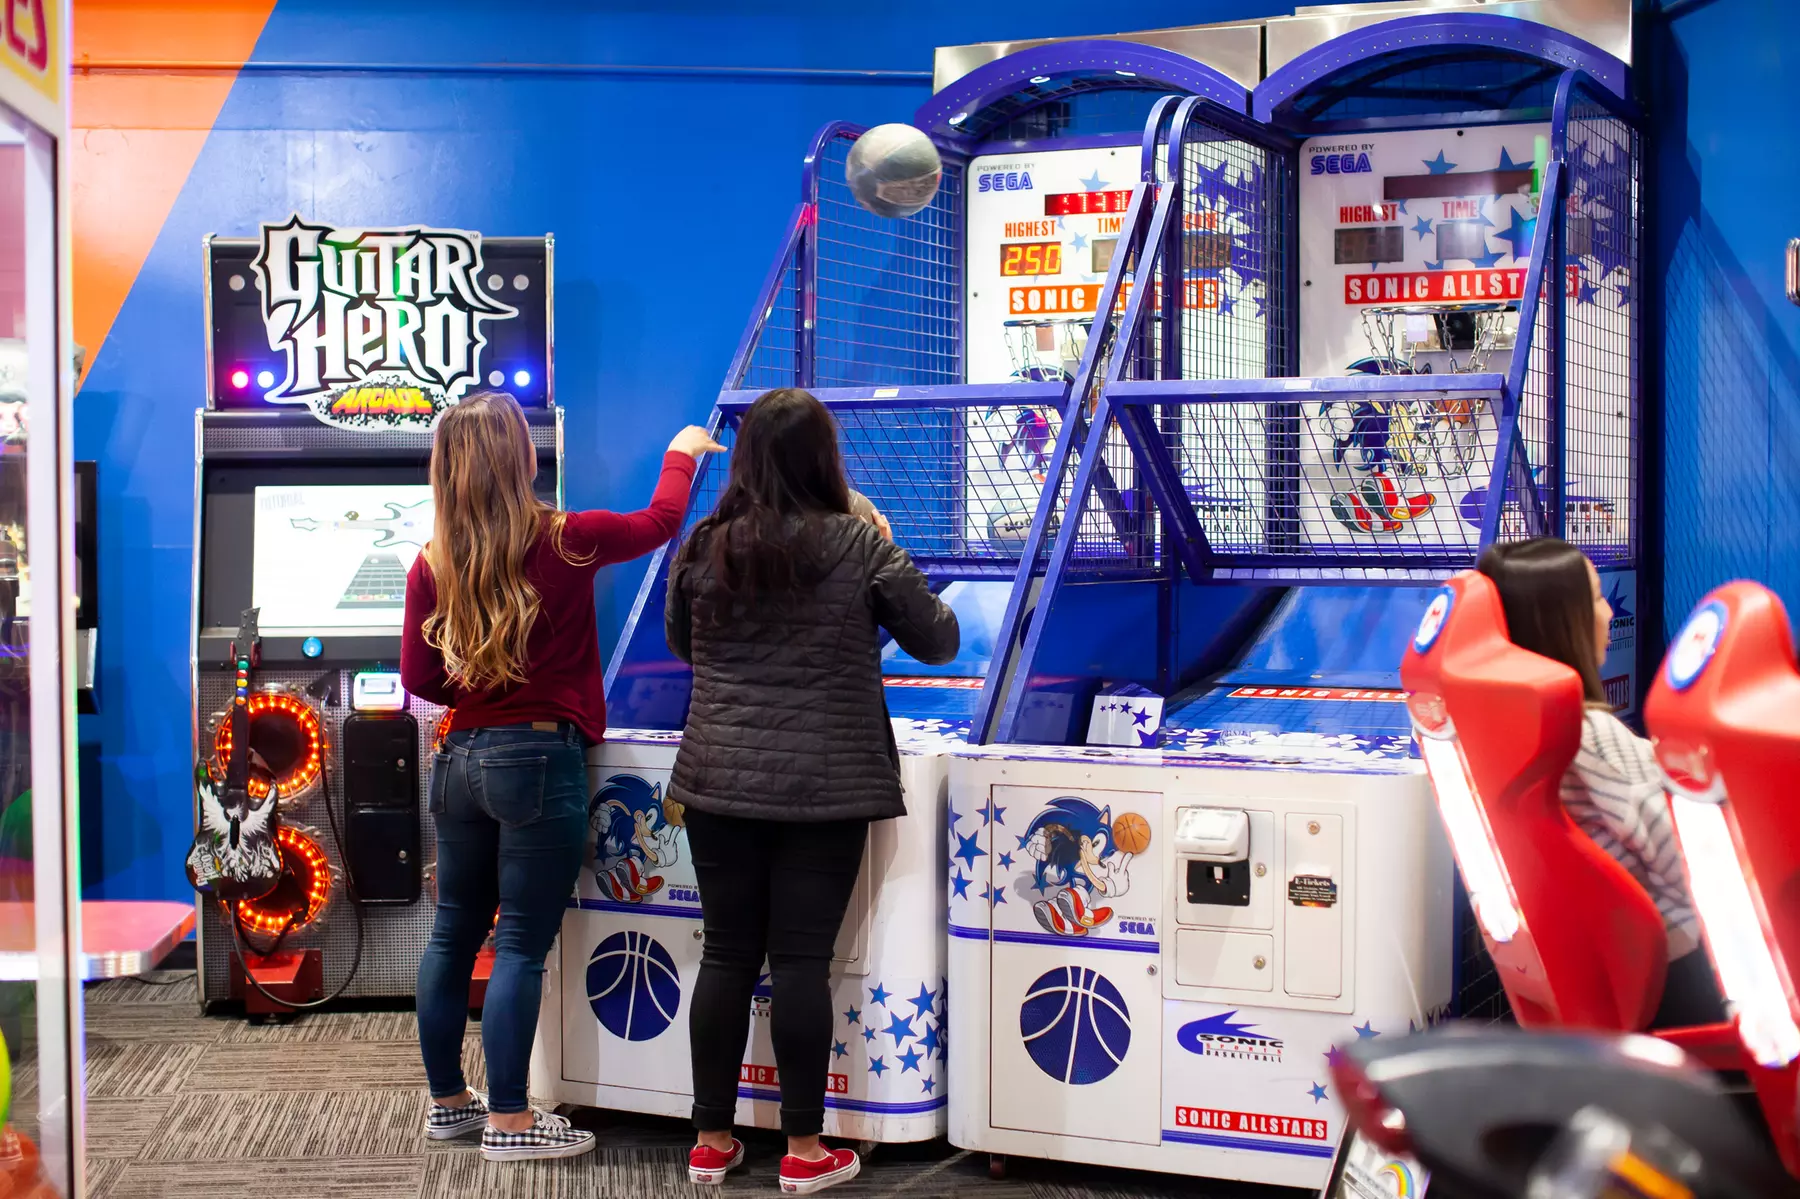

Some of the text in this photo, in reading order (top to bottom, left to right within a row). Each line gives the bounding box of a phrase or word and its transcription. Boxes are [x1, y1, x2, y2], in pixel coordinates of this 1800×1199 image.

[1308, 144, 1358, 153] POWERED
[1310, 153, 1372, 175] SEGA
[978, 171, 1034, 193] SEGA
[1442, 200, 1478, 219] TIME
[1004, 220, 1057, 239] HIGHEST
[1097, 216, 1124, 234] TIM
[1003, 245, 1062, 275] 250
[1349, 270, 1574, 301] SONIC ALLSTS
[1012, 286, 1086, 312] SONIC
[331, 387, 434, 415] ARCADE
[1239, 687, 1331, 698] SONIC
[668, 888, 700, 903] SEGA
[1118, 920, 1156, 936] SEGA
[1199, 1033, 1284, 1049] SONIC
[1206, 1049, 1282, 1064] BASKETBALL
[741, 1065, 767, 1083] NIC
[1178, 1107, 1326, 1139] SONIC ALLSTARS
